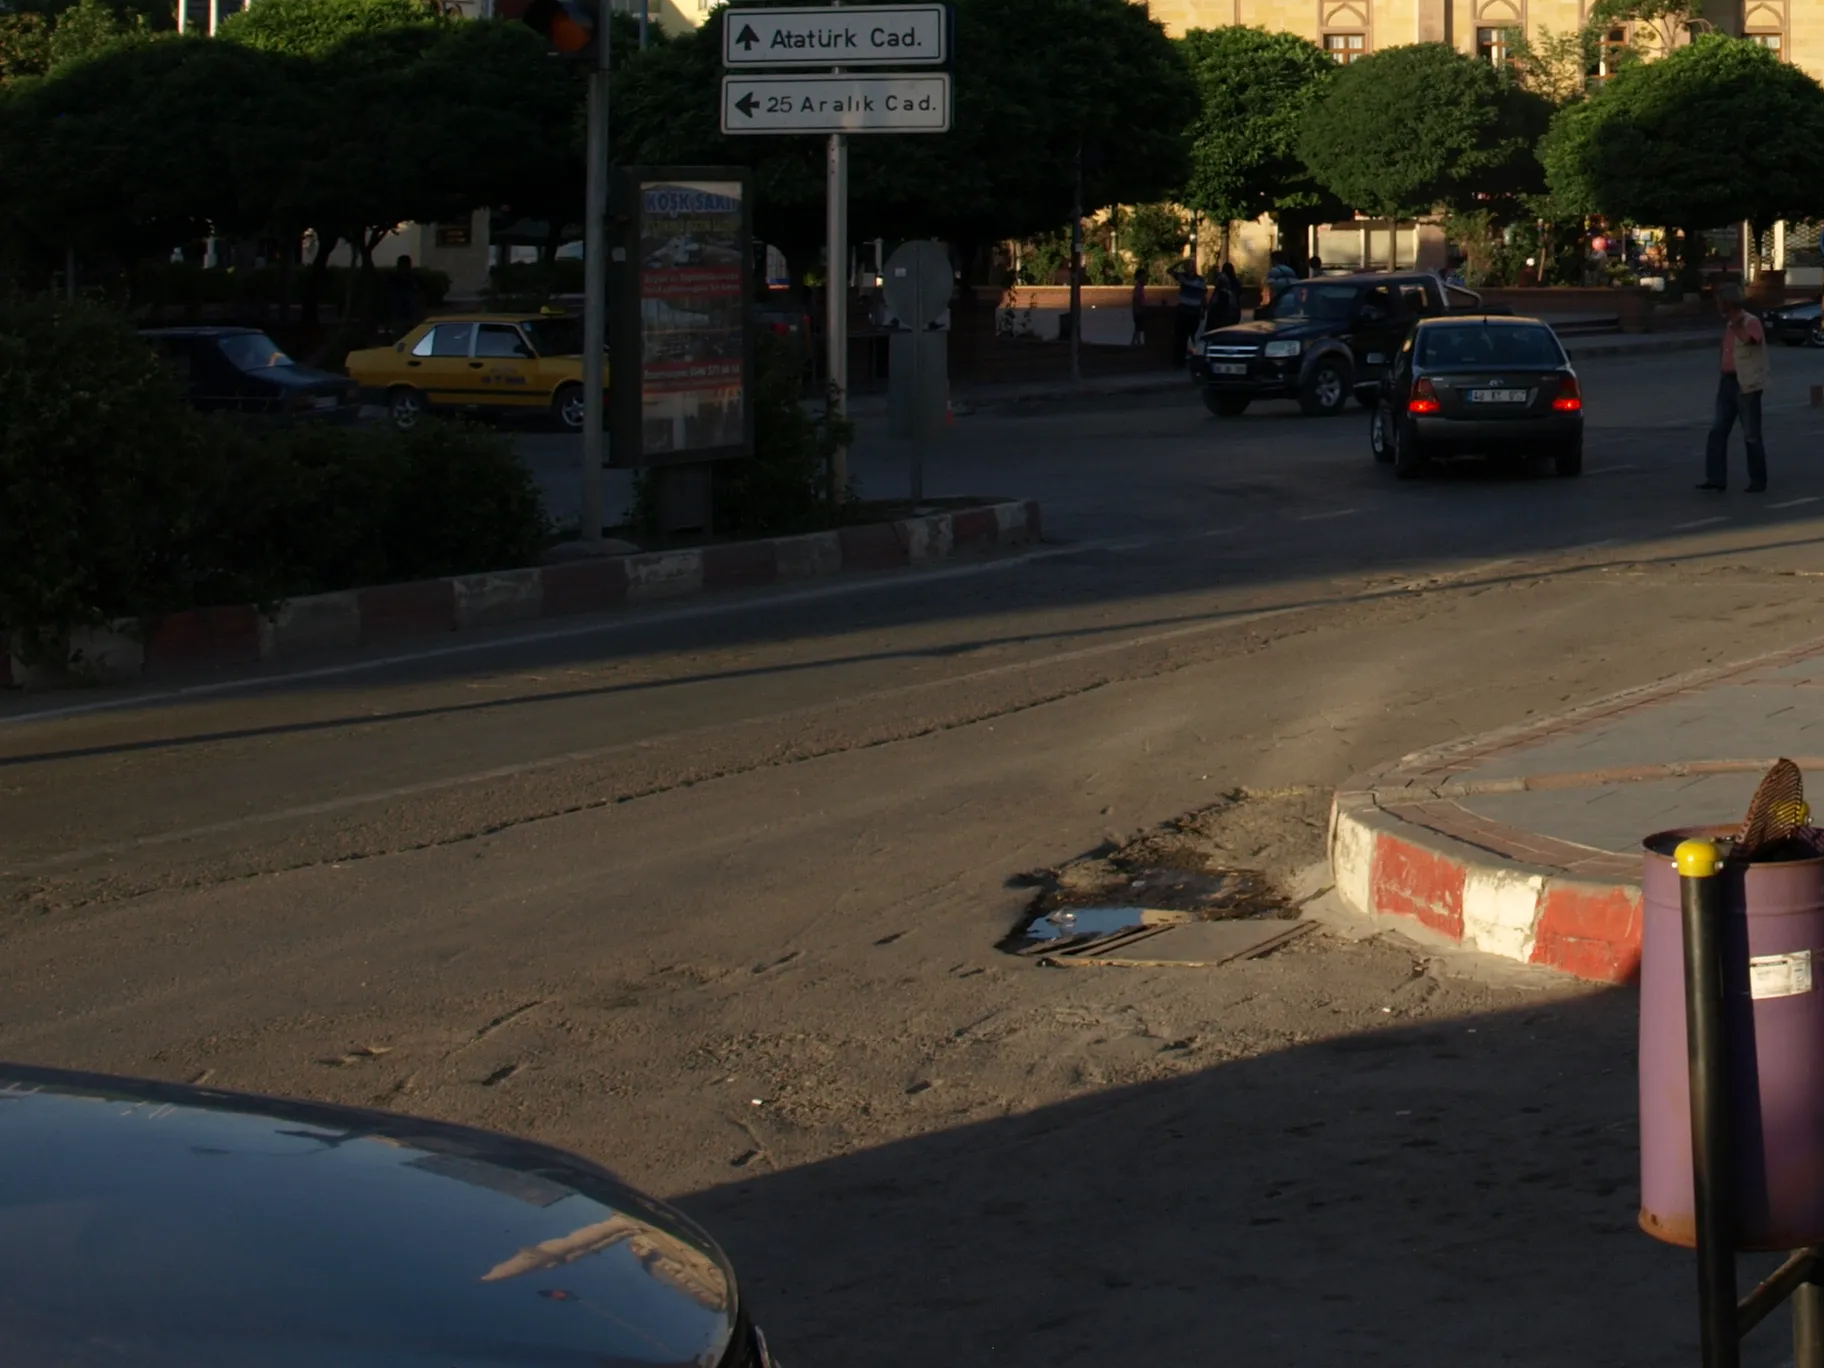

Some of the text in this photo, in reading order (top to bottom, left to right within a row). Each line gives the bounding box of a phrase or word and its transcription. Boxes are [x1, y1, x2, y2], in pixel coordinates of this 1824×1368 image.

[770, 27, 922, 49] Atatürk Cad.
[766, 94, 937, 113] 25 Aralık Cad.
